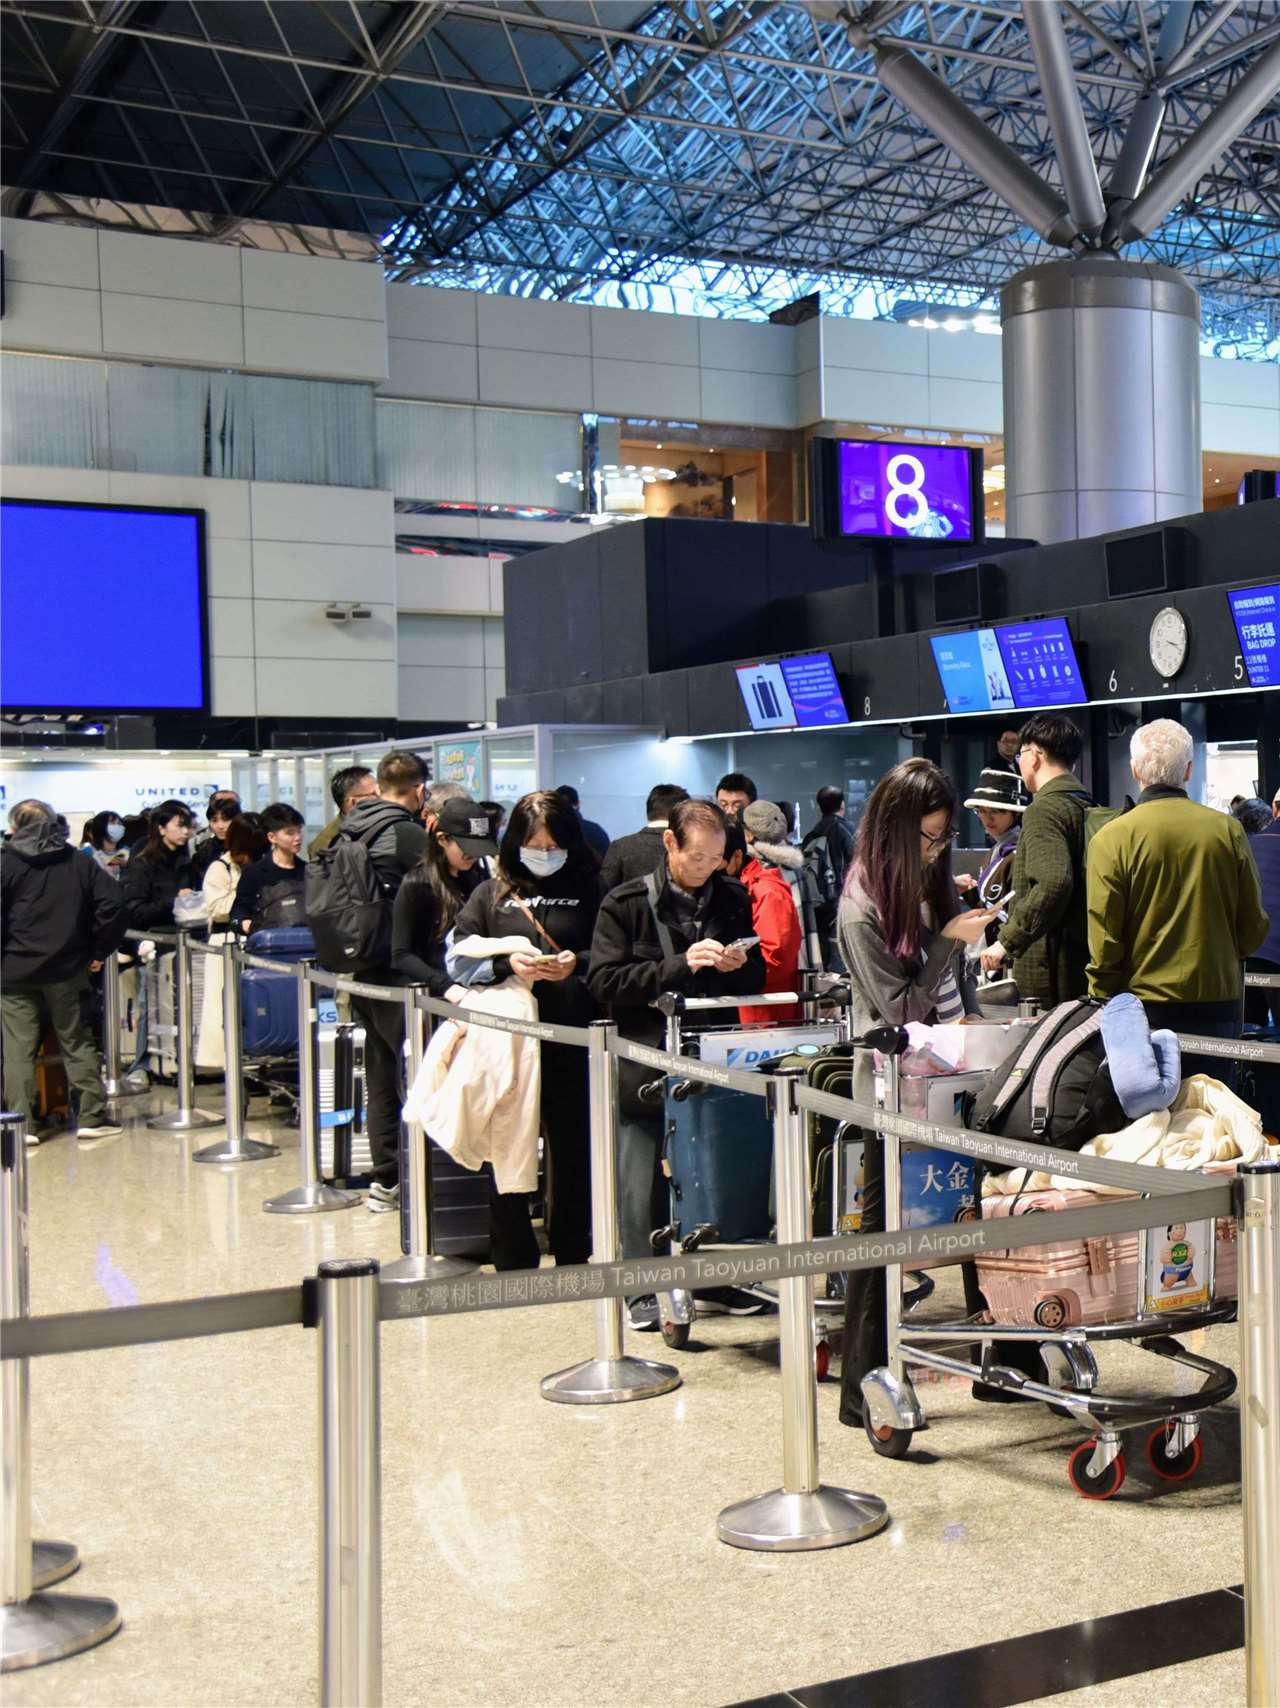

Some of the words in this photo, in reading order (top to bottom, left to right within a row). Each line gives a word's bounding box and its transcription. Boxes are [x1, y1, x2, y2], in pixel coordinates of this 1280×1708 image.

[885, 454, 929, 528] 8
[1246, 639, 1261, 650] BAG
[1234, 656, 1243, 680] 5
[1109, 669, 1118, 692] 6
[864, 696, 871, 716] 8
[135, 784, 201, 796] UNITED
[1240, 1044, 1264, 1058] Airport
[934, 1127, 960, 1146] Taiwan
[960, 1133, 993, 1159] Taoyuan
[995, 1143, 1047, 1167] International
[1047, 1152, 1080, 1174] Airport
[920, 1161, 977, 1197] 大金
[396, 1271, 605, 1313] 臺灣桃園國際機場
[611, 1264, 687, 1288] Taiwan
[691, 1254, 781, 1282] Taoyuan
[786, 1237, 913, 1269] International
[915, 1229, 987, 1257] Airport
